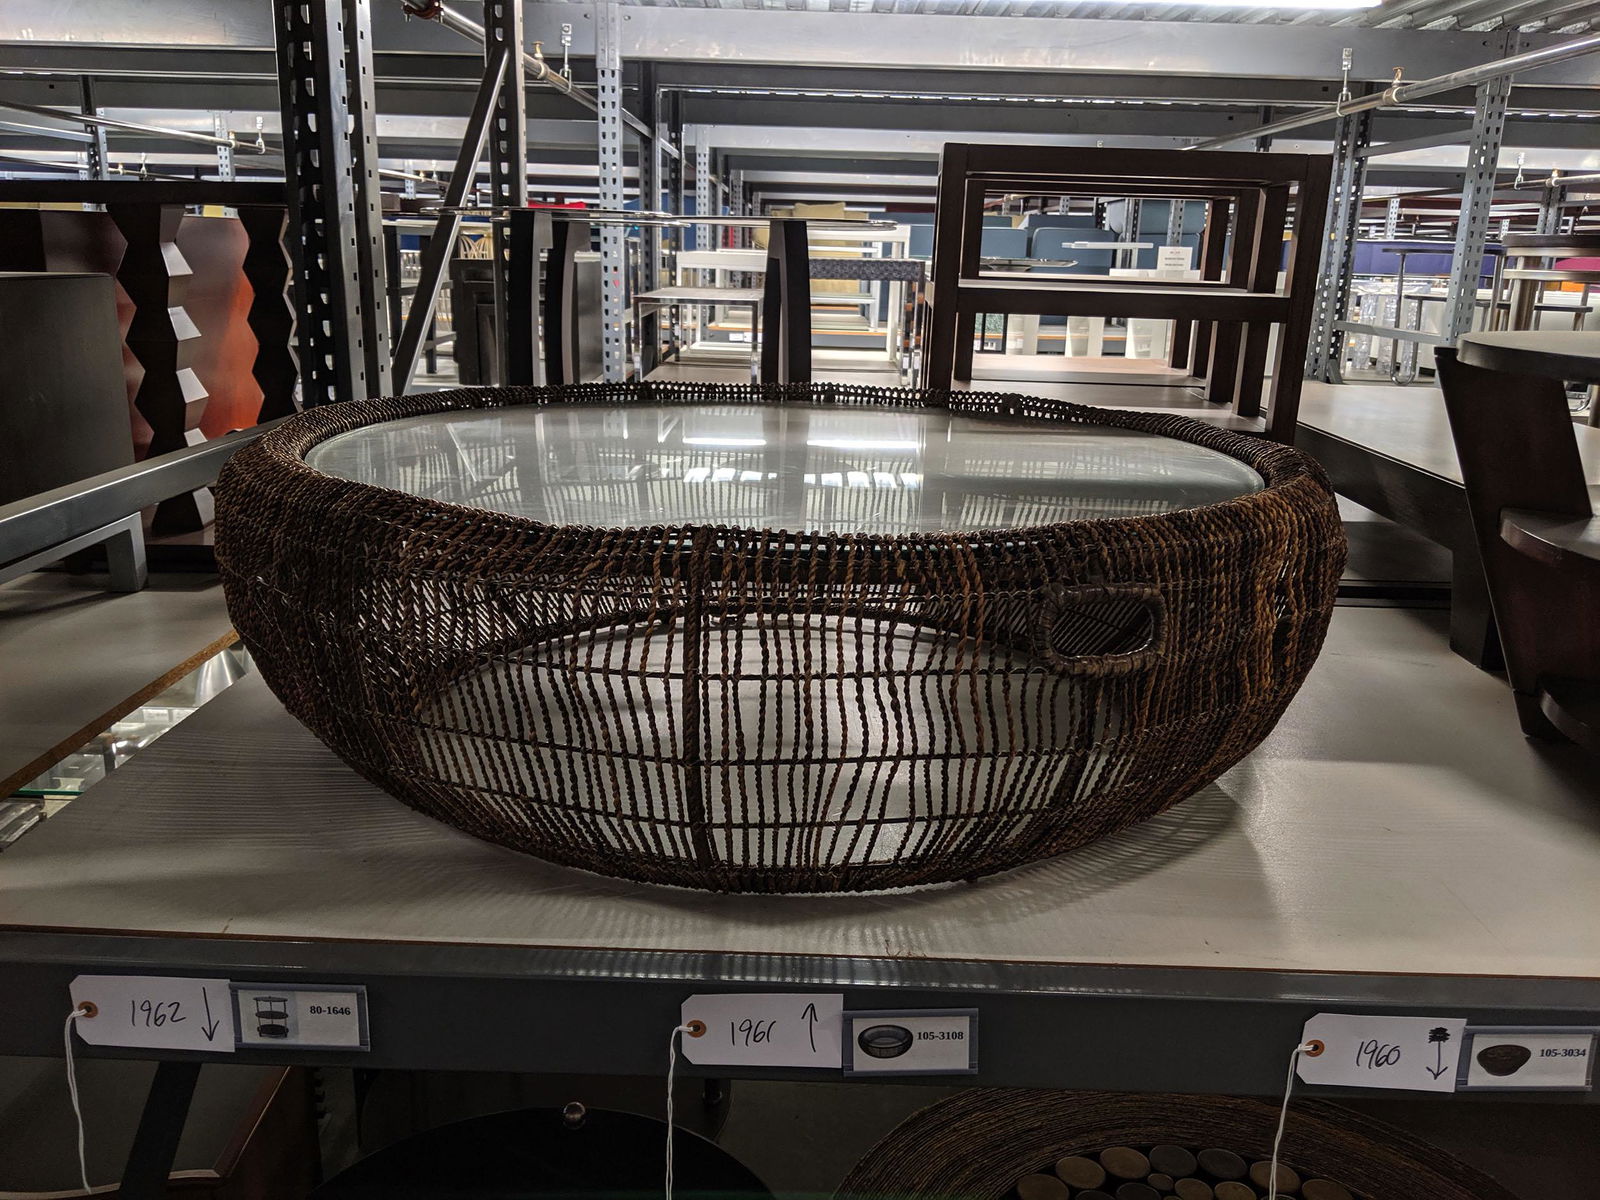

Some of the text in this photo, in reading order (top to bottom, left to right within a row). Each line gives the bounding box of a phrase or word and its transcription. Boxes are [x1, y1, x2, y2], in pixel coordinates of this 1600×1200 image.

[131, 999, 186, 1028] 1962
[309, 1005, 352, 1016] 80-1646
[916, 1031, 964, 1041] 105-3108
[1355, 1039, 1401, 1070] 1960
[1539, 1048, 1587, 1058] 105-3034
